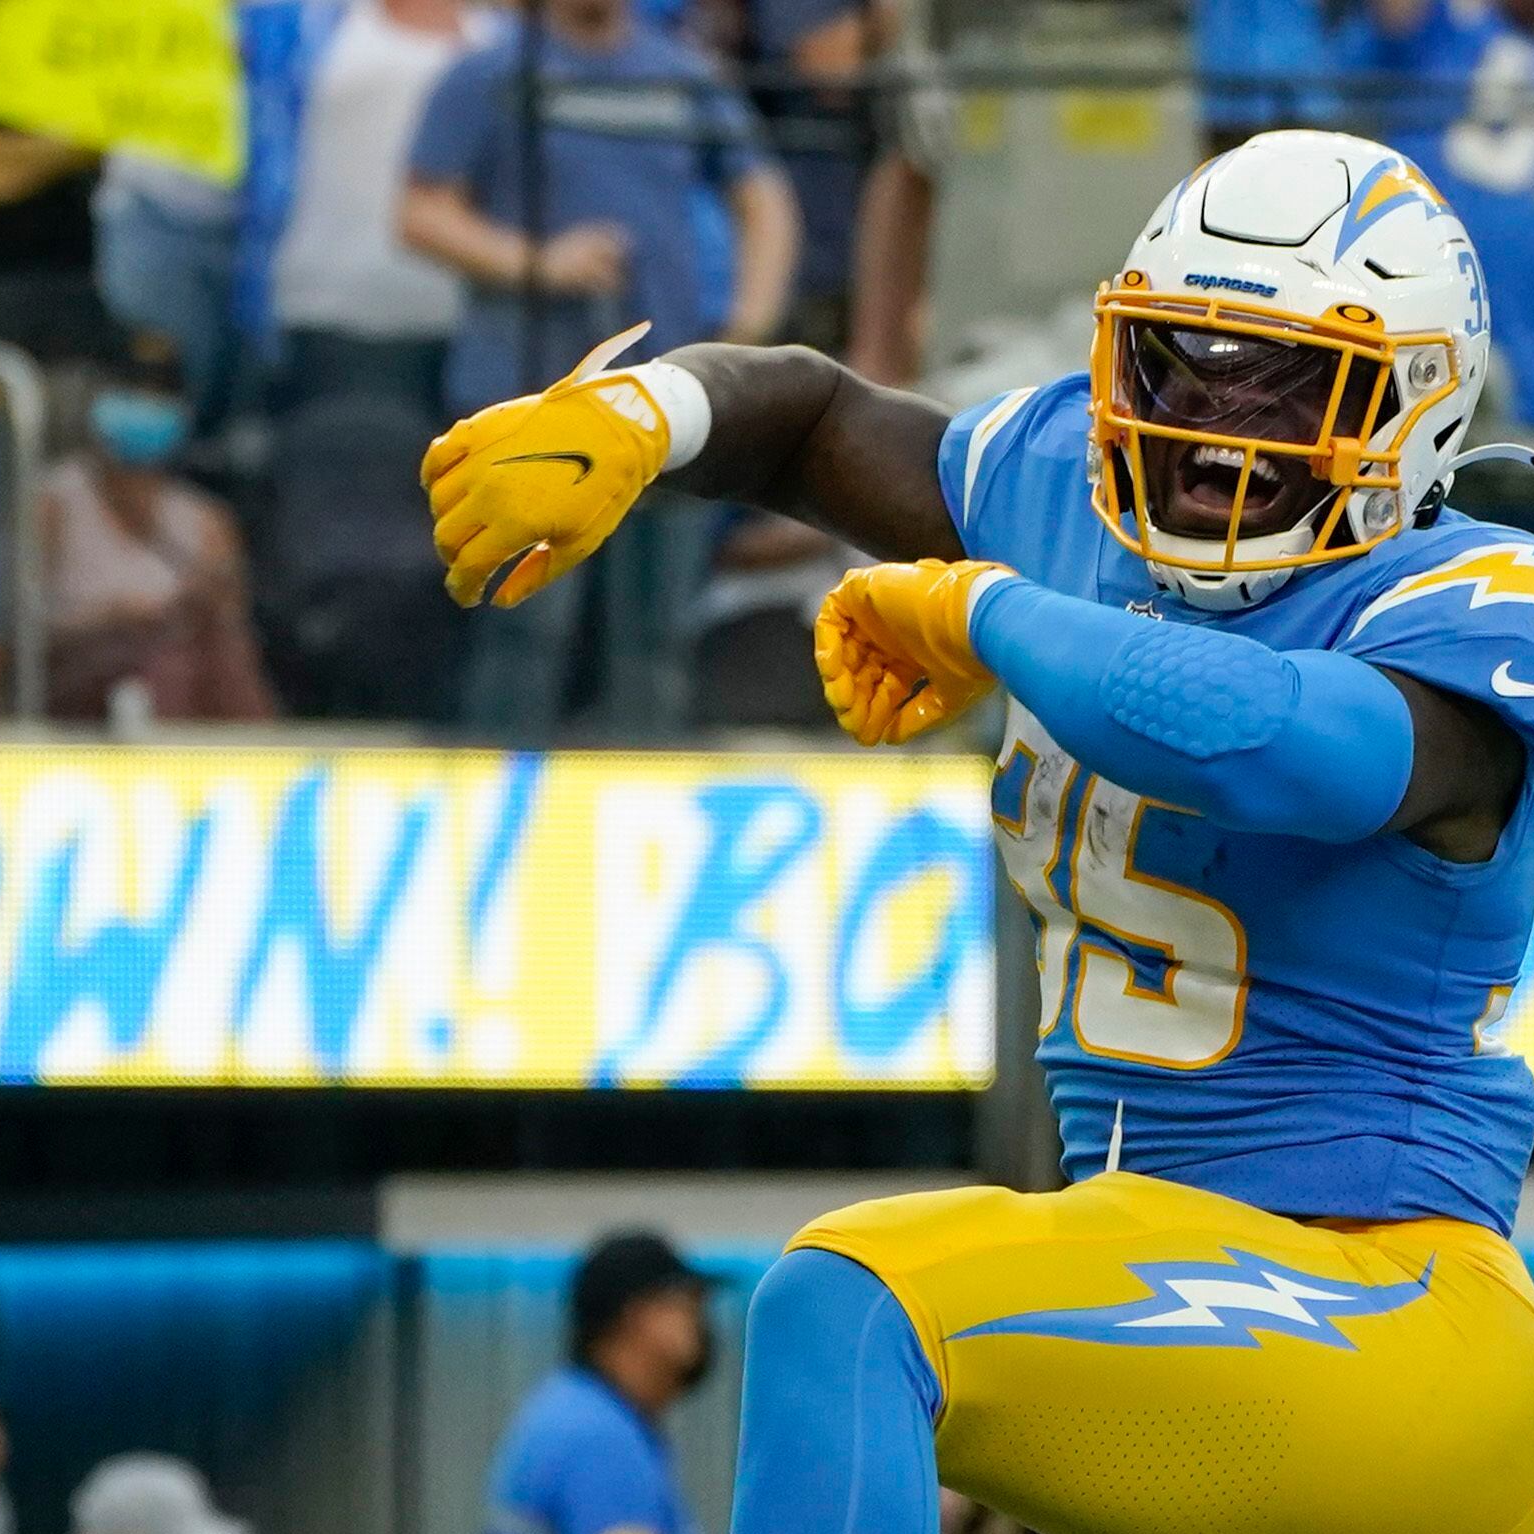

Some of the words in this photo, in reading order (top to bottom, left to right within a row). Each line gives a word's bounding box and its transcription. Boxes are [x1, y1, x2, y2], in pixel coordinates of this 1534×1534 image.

[1183, 272, 1279, 298] CHARGERS
[1457, 250, 1490, 337] 3
[991, 694, 1250, 1071] 35
